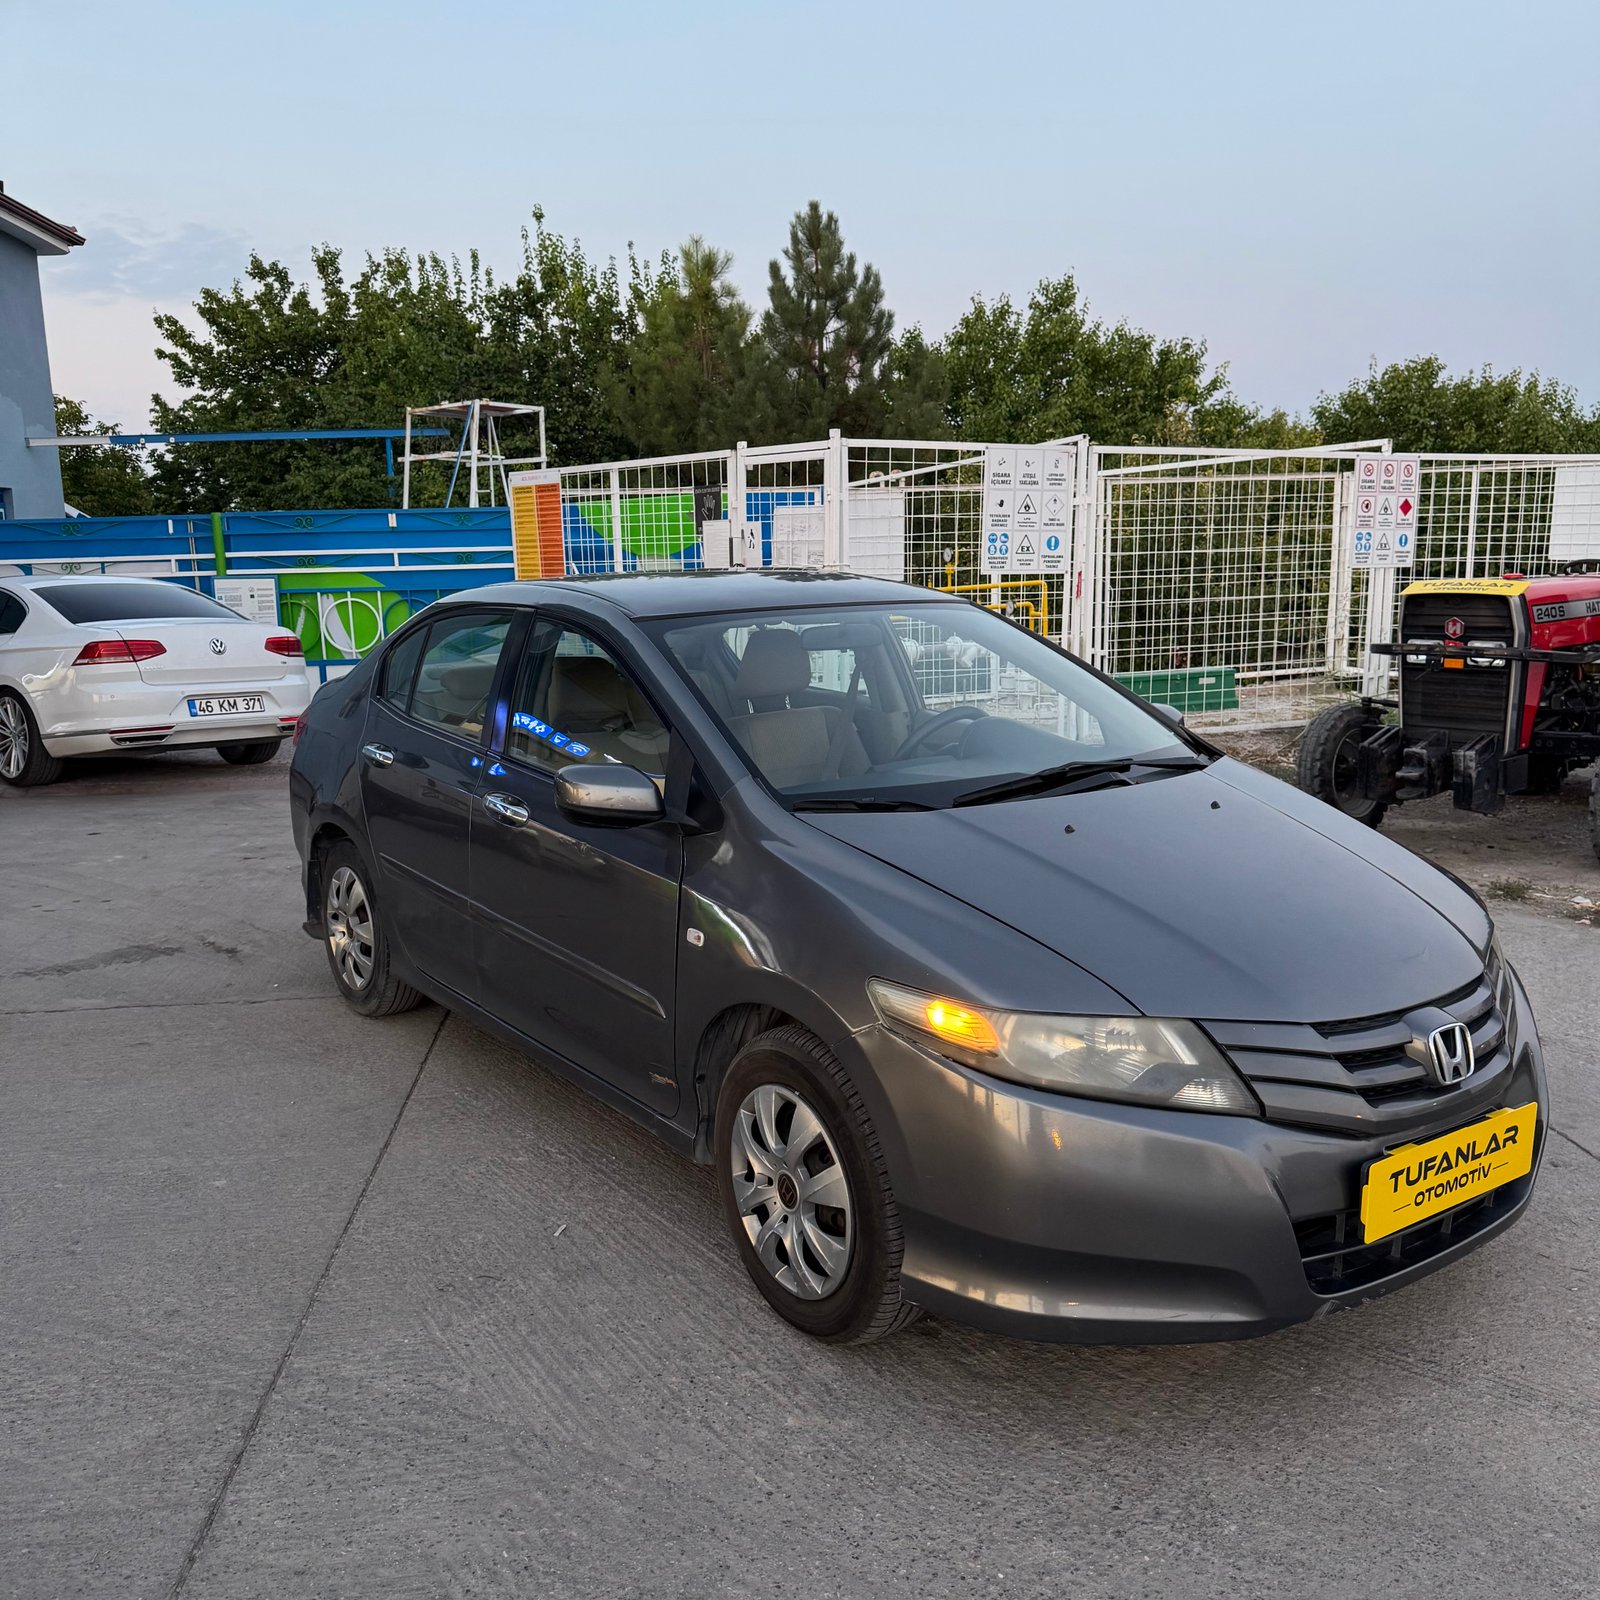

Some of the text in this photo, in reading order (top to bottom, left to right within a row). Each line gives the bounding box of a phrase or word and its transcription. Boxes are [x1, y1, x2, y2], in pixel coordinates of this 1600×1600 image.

[1536, 605, 1565, 620] 240S
[199, 697, 263, 713] 46 KM 371
[1389, 1125, 1519, 1193] TUFANLAR
[1414, 1162, 1492, 1207] OTOMOTİV
